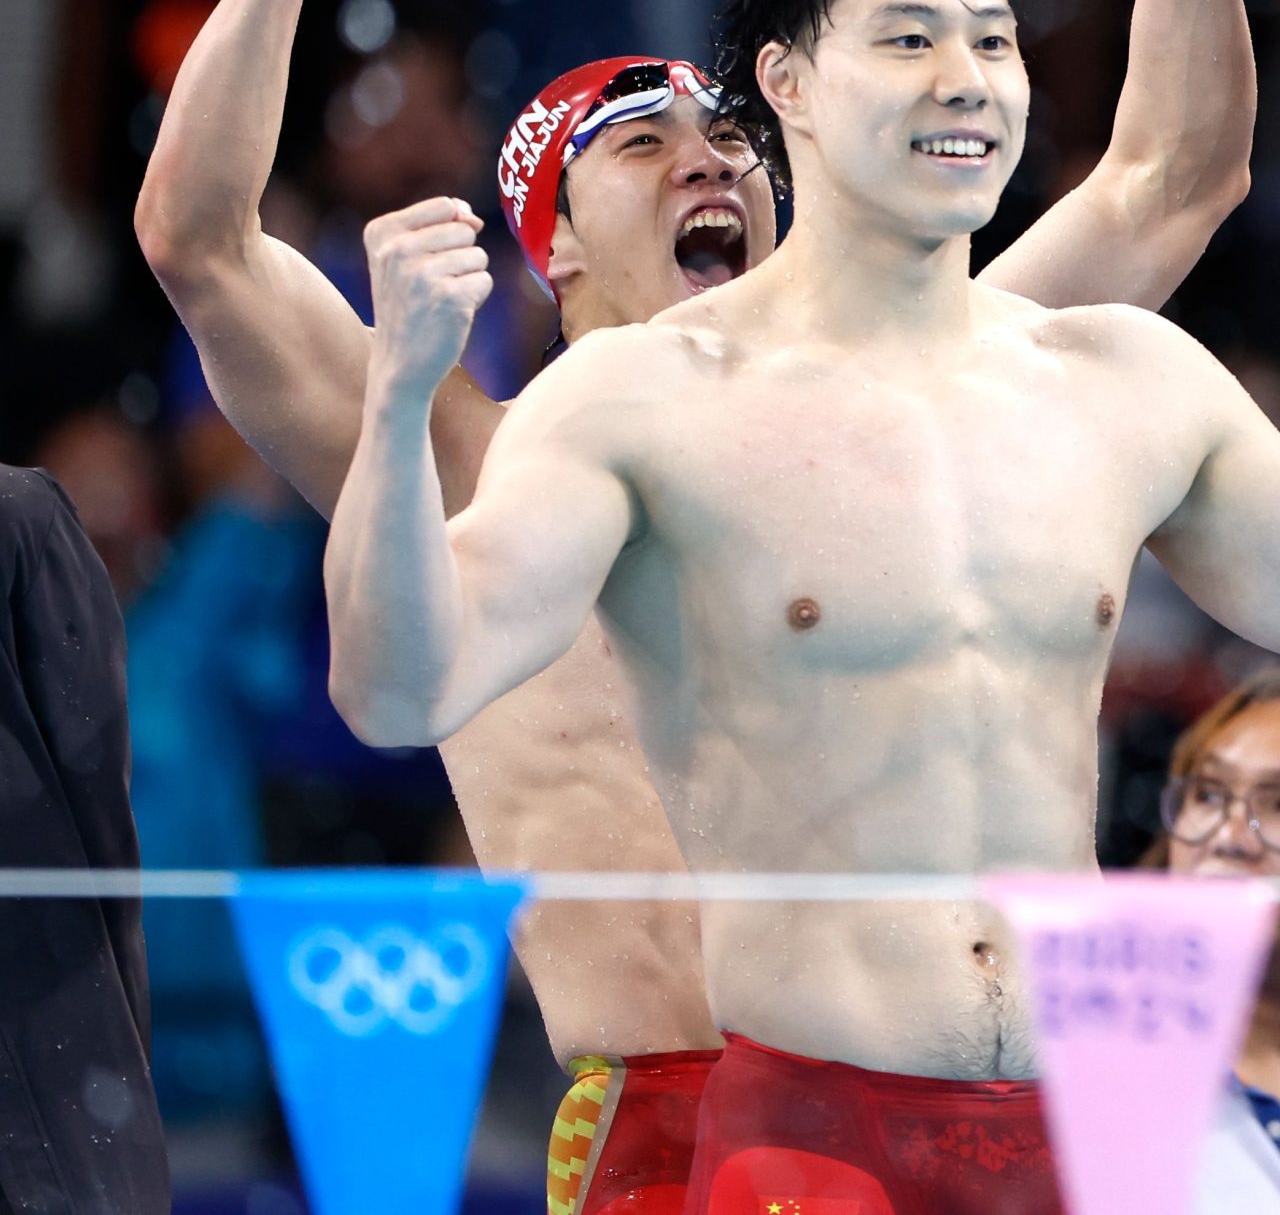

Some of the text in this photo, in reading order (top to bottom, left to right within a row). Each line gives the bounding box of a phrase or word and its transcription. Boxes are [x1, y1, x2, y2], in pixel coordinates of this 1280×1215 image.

[498, 99, 550, 198] CHN
[513, 100, 571, 228] SUN JIAJUN
